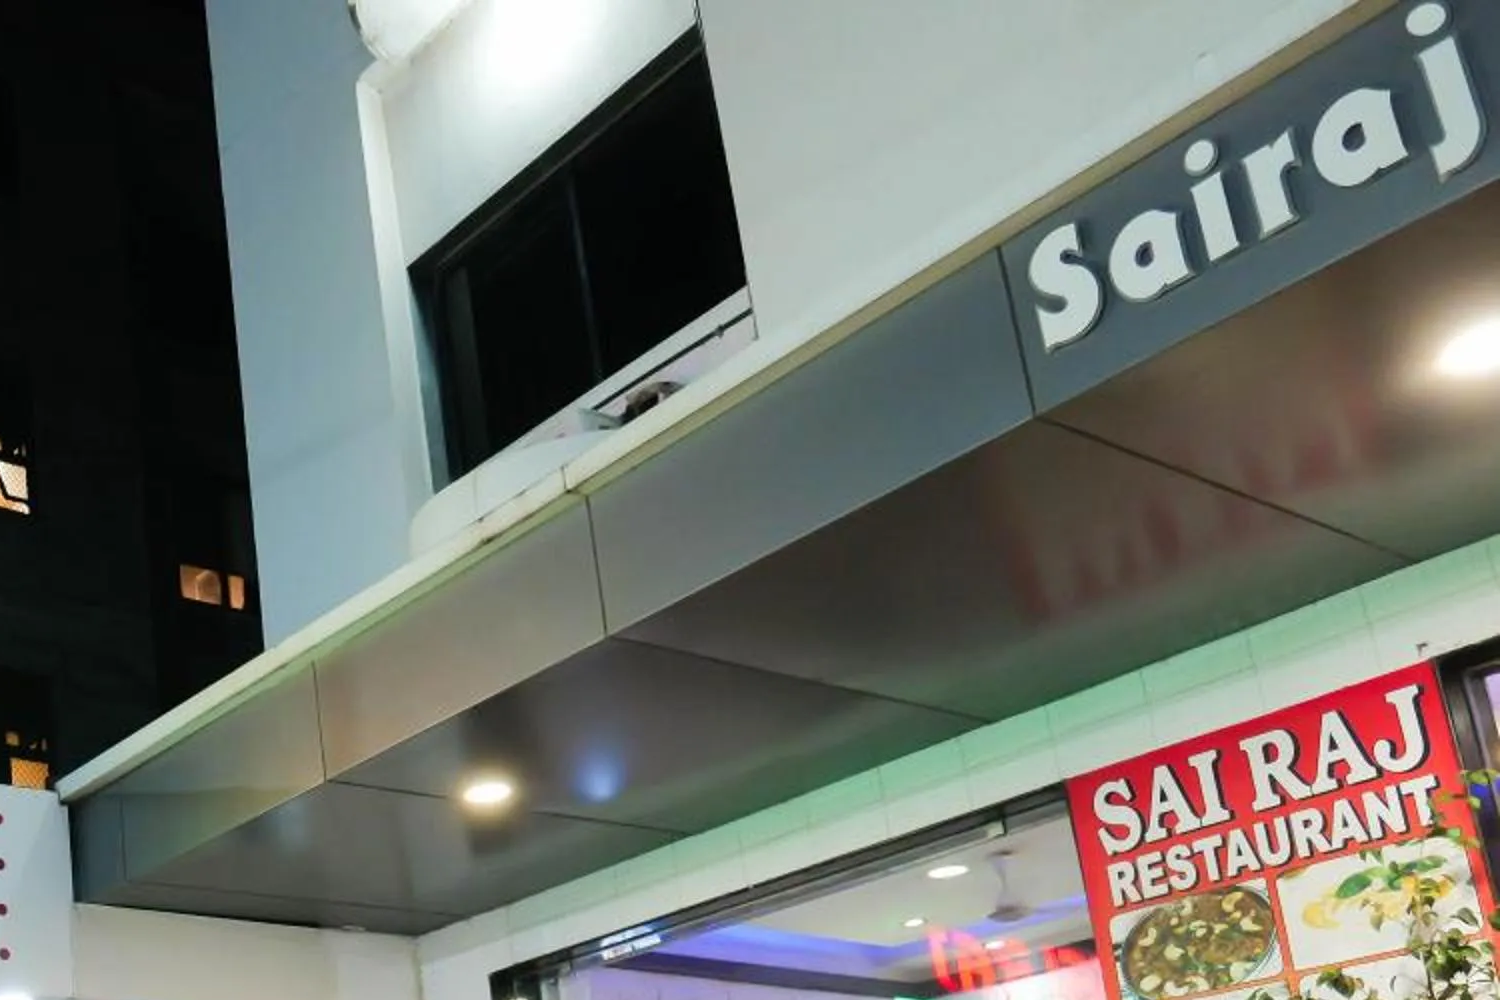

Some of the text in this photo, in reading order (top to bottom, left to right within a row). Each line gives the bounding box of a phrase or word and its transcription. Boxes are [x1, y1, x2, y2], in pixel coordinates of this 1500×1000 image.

[1028, 1, 1488, 354] Sairaj
[1093, 684, 1427, 857] SAI RAJ
[1106, 775, 1440, 907] RESTAURANT
